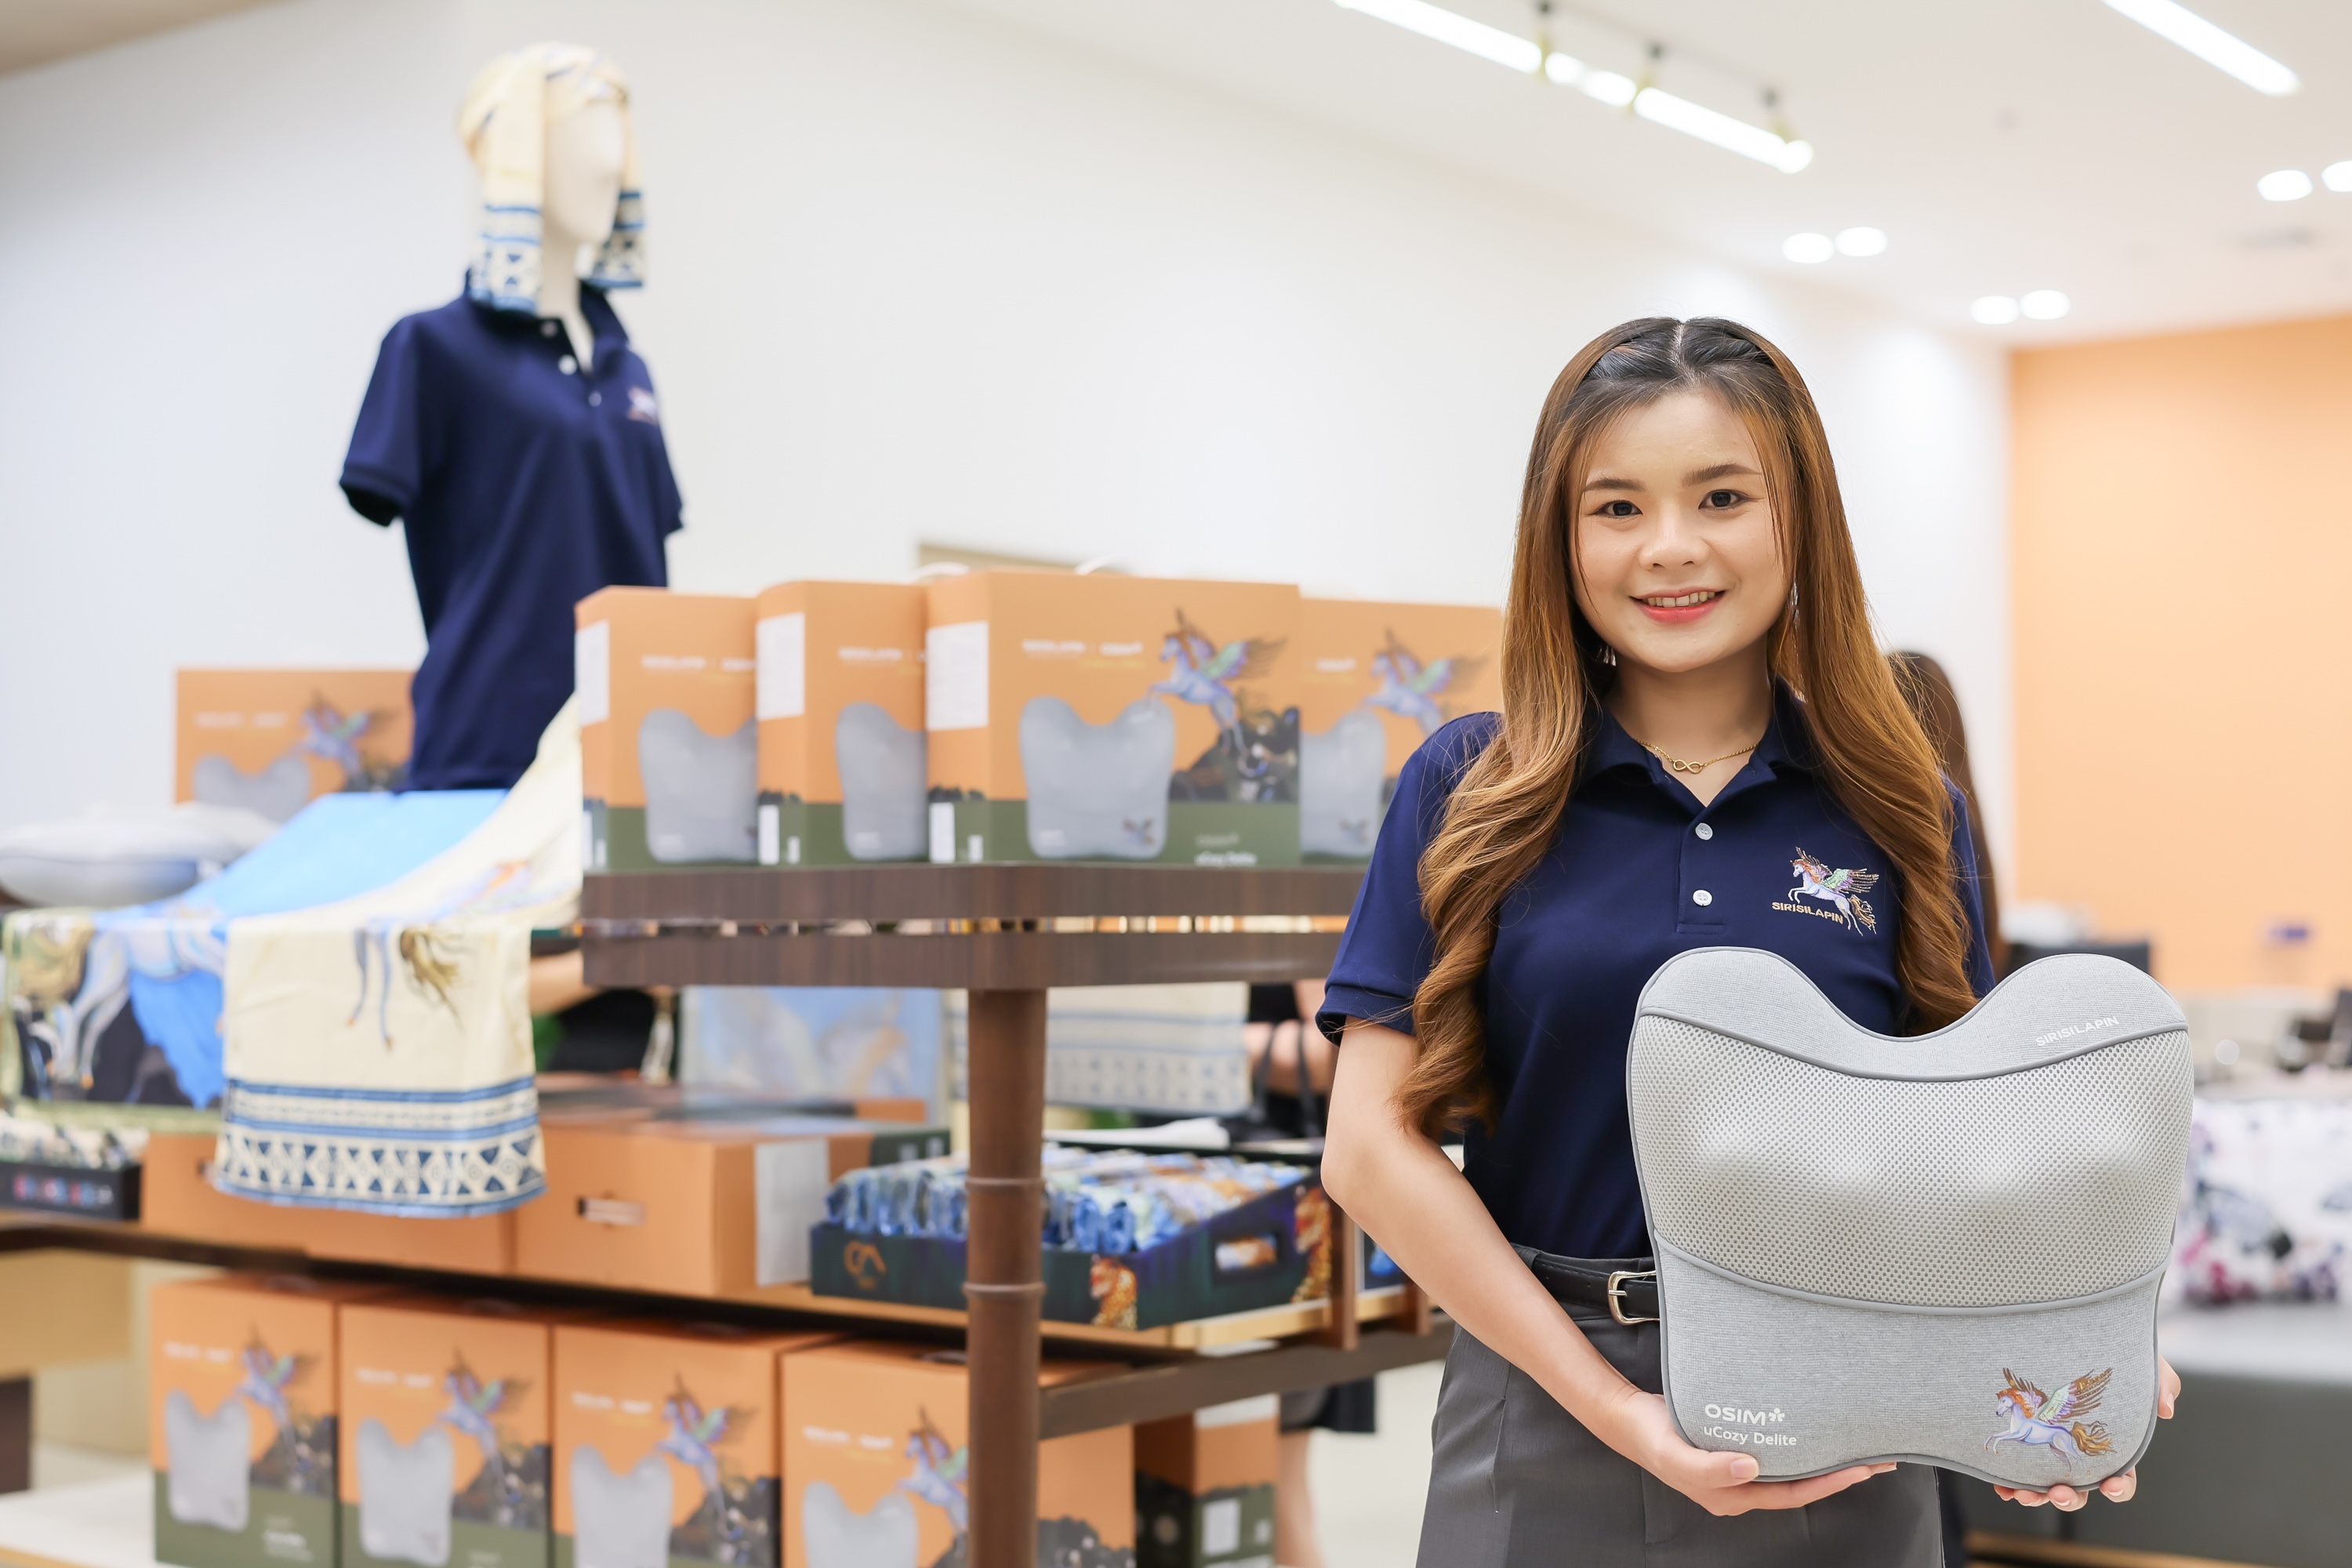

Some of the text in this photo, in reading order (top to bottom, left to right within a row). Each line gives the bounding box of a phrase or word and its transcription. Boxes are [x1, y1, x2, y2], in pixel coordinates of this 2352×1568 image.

[1771, 902, 1844, 924] SIRISILAPIN
[2035, 1016, 2120, 1047] SIRISILAPIN
[1704, 1403, 1766, 1426] OSIM
[1703, 1425, 1798, 1446] uCozy Delite
